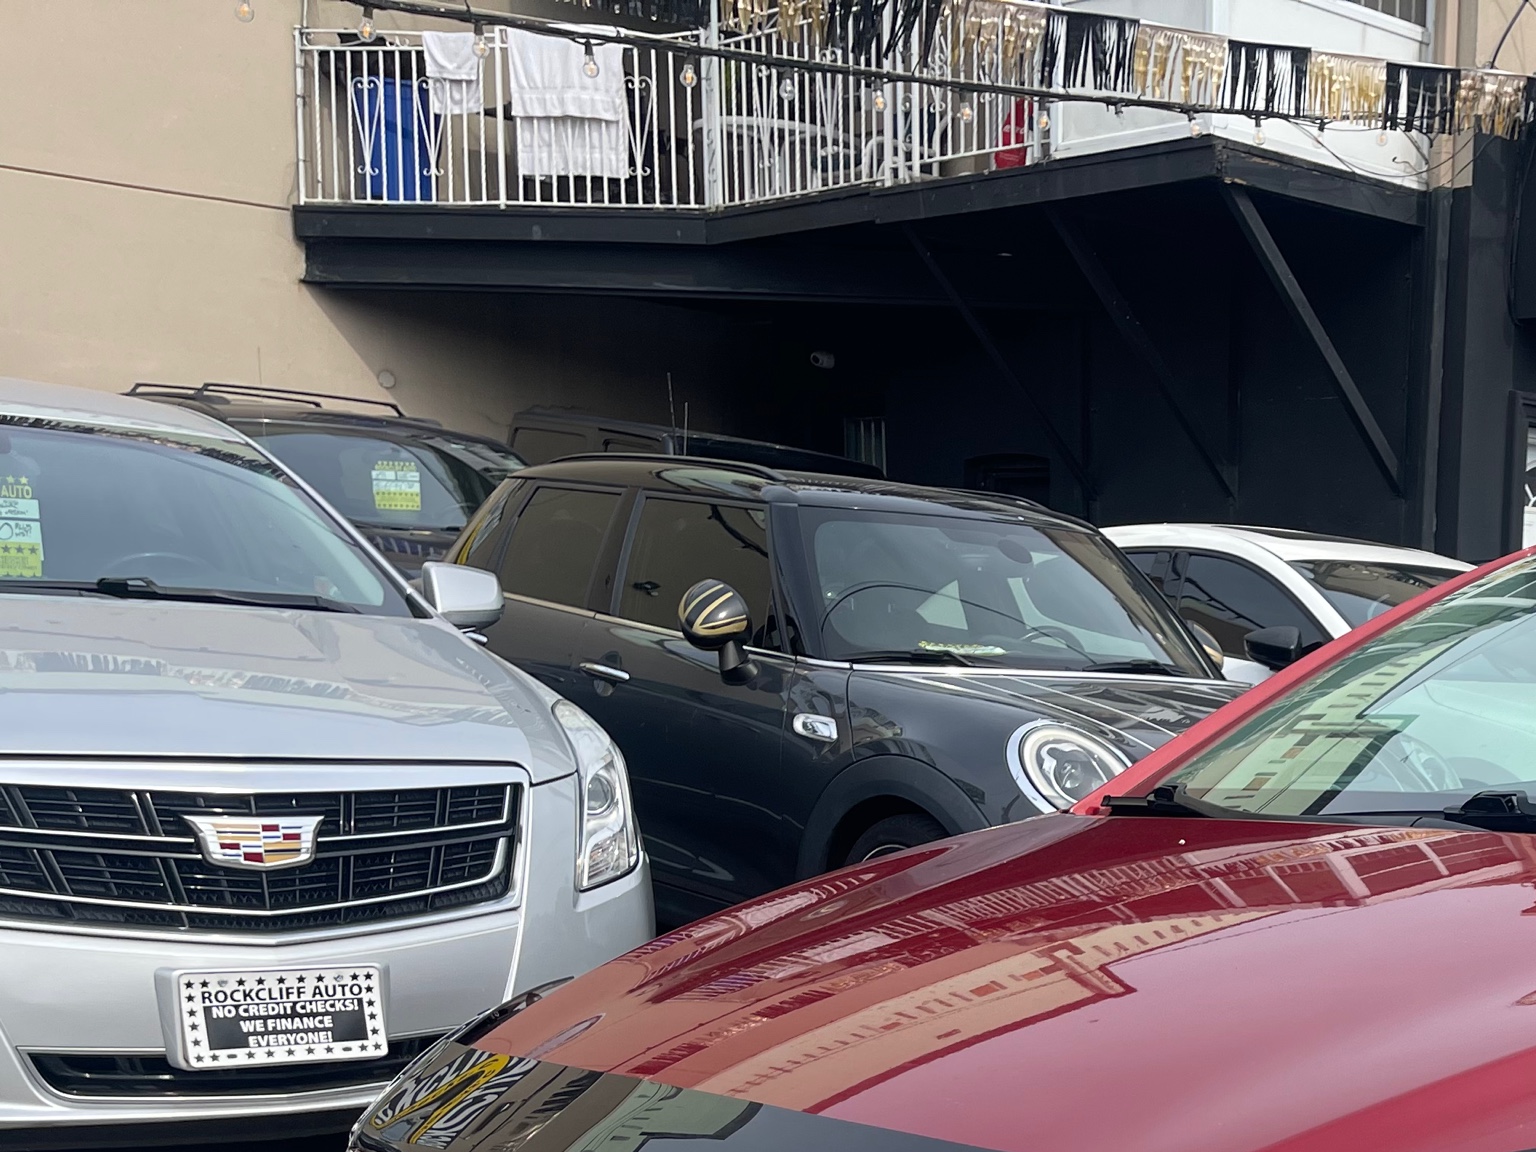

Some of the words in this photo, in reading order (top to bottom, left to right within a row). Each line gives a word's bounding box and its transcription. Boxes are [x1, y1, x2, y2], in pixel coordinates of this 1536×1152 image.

[1, 484, 32, 499] AUTO
[201, 986, 306, 1004] ROCKCLIFF
[312, 983, 363, 999] AUTO
[212, 1004, 237, 1018] NO
[239, 1002, 293, 1017] CREDIT
[296, 999, 359, 1014] CHECKS!
[240, 1020, 265, 1033] WE
[268, 1016, 333, 1031] FINANCE
[249, 1031, 333, 1047] EVERYONE!
